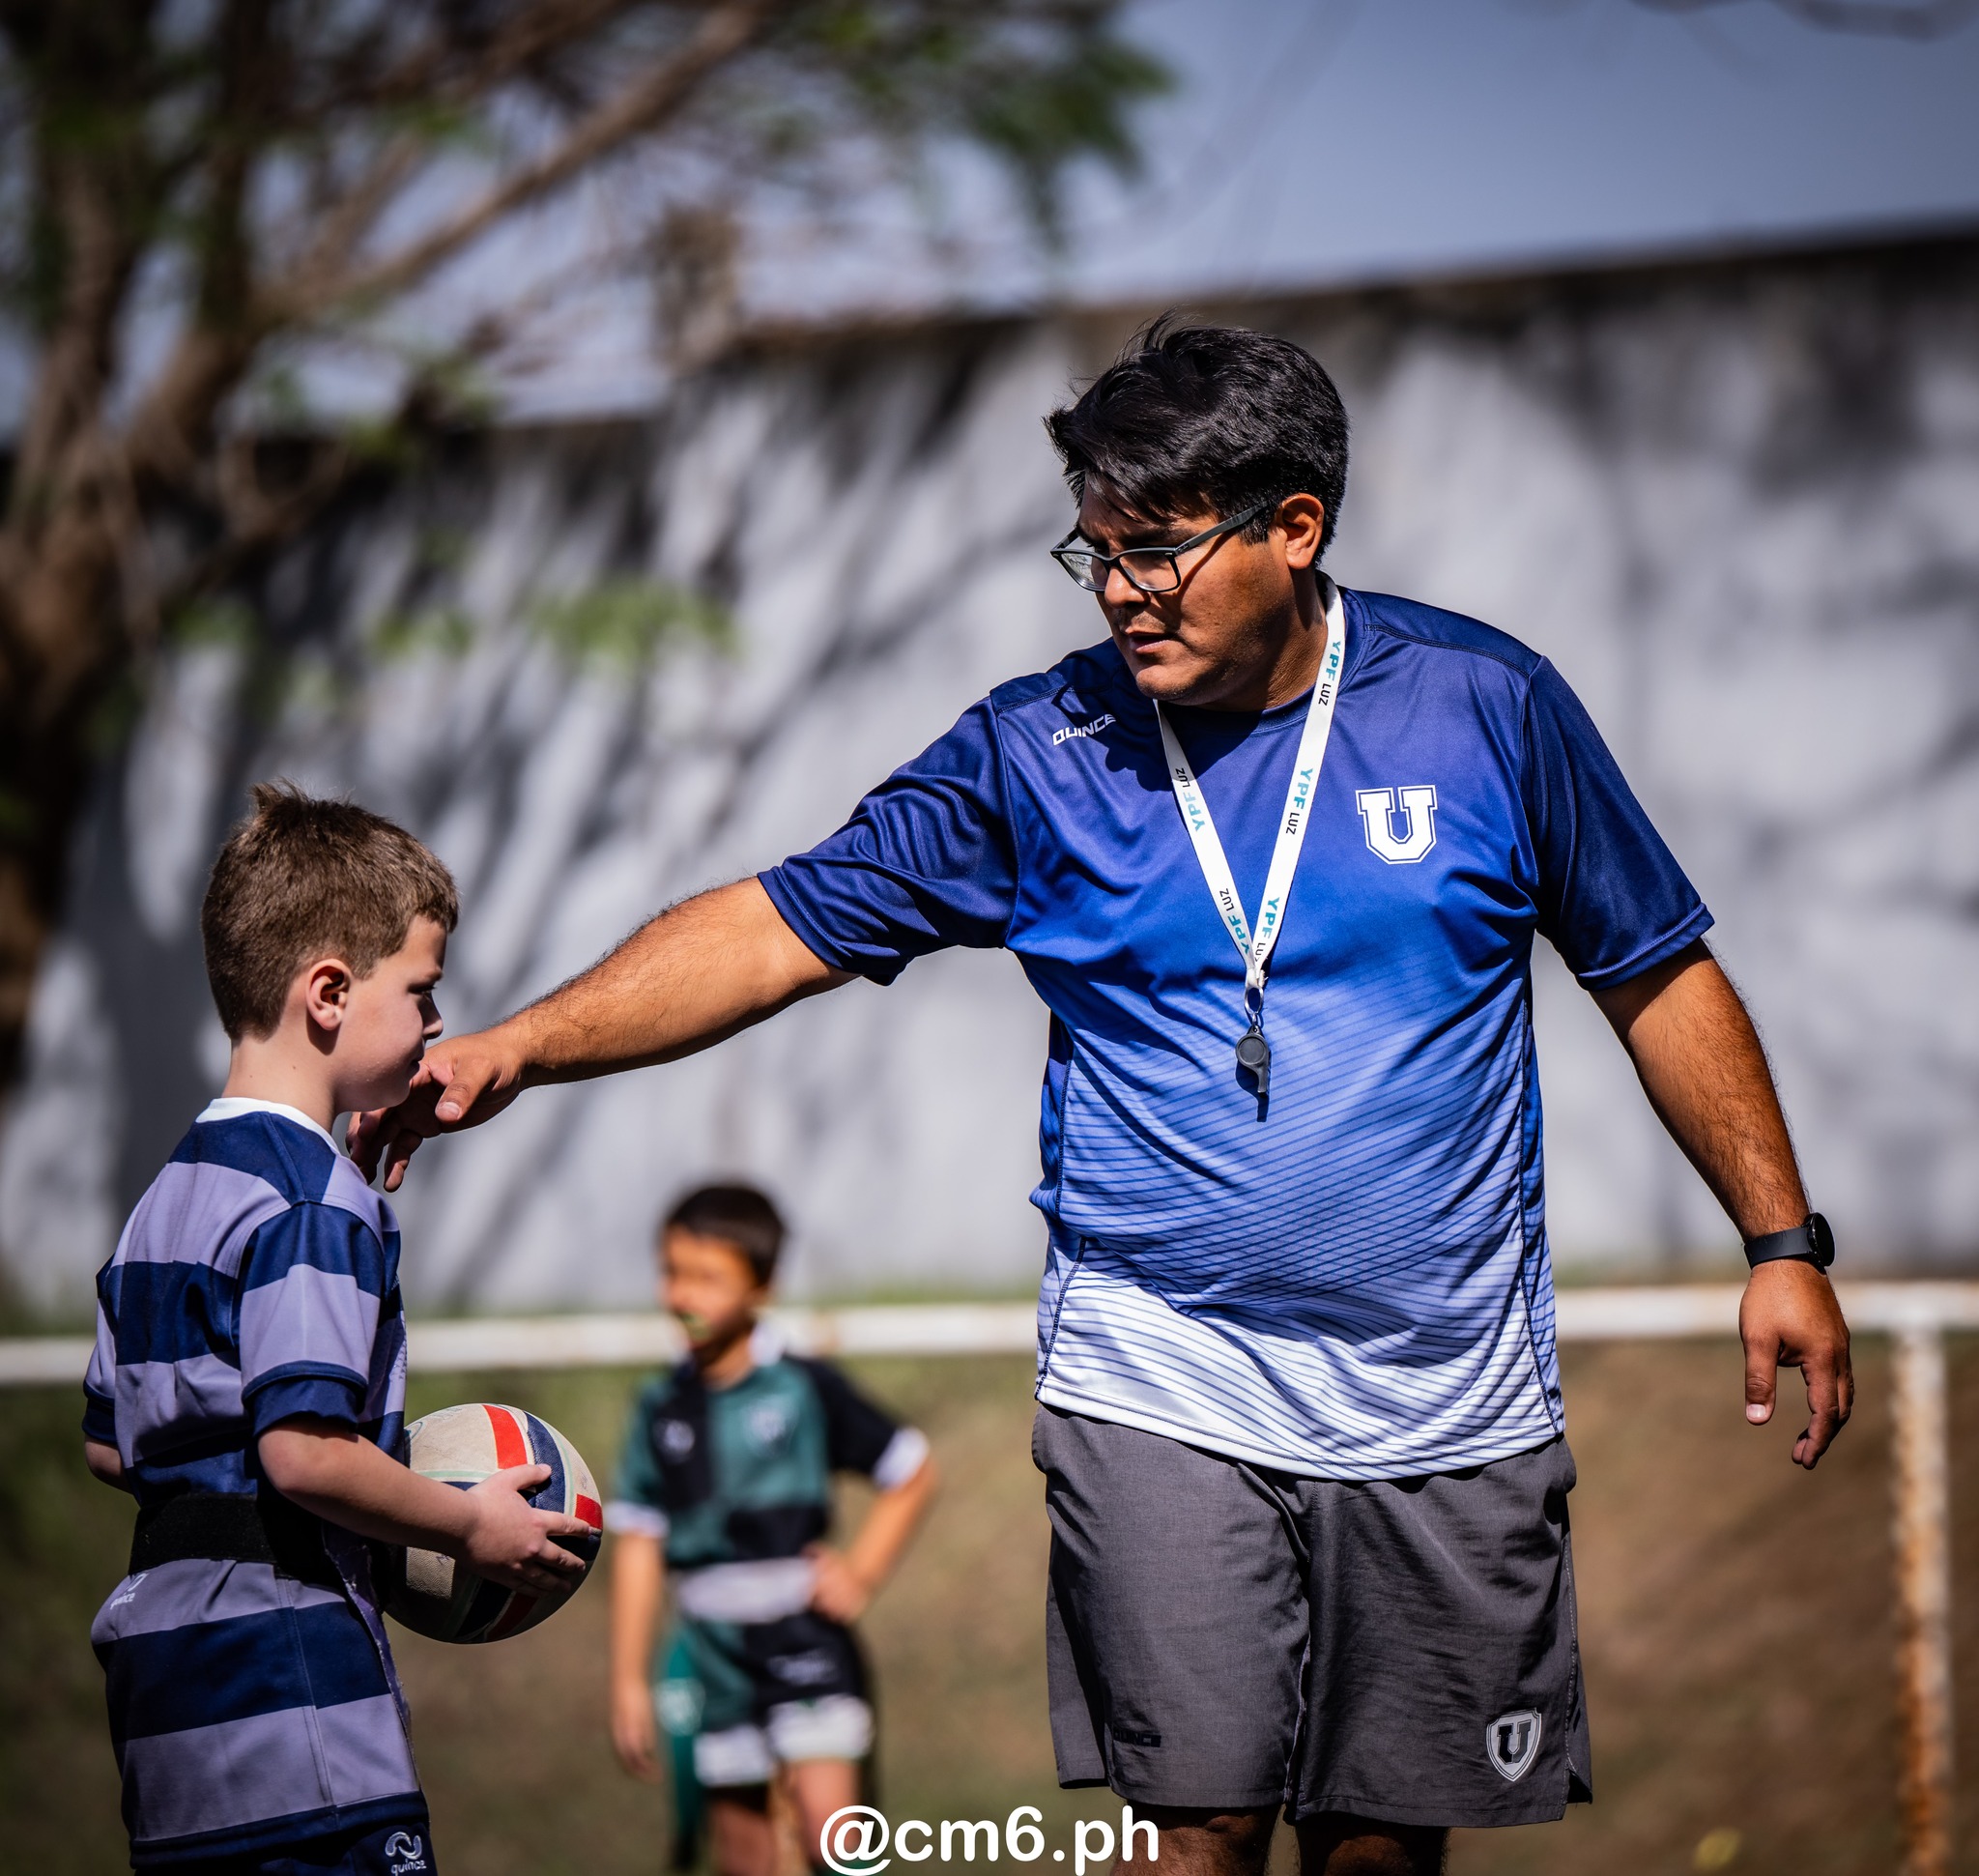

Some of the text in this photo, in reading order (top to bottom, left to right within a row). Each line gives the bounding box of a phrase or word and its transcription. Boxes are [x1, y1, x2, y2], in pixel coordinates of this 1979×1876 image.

[1318, 641, 1341, 707] YPF LUZ
[1051, 713, 1117, 746] QUINCE
[1175, 767, 1206, 832] YPF LUZ
[1285, 767, 1314, 835] YPF LUZ
[1355, 784, 1439, 865] U
[1219, 887, 1250, 955] YPF LUZ
[1261, 896, 1280, 939] YPF
[1496, 1718, 1533, 1766] U
[390, 1858, 427, 1876] quince
